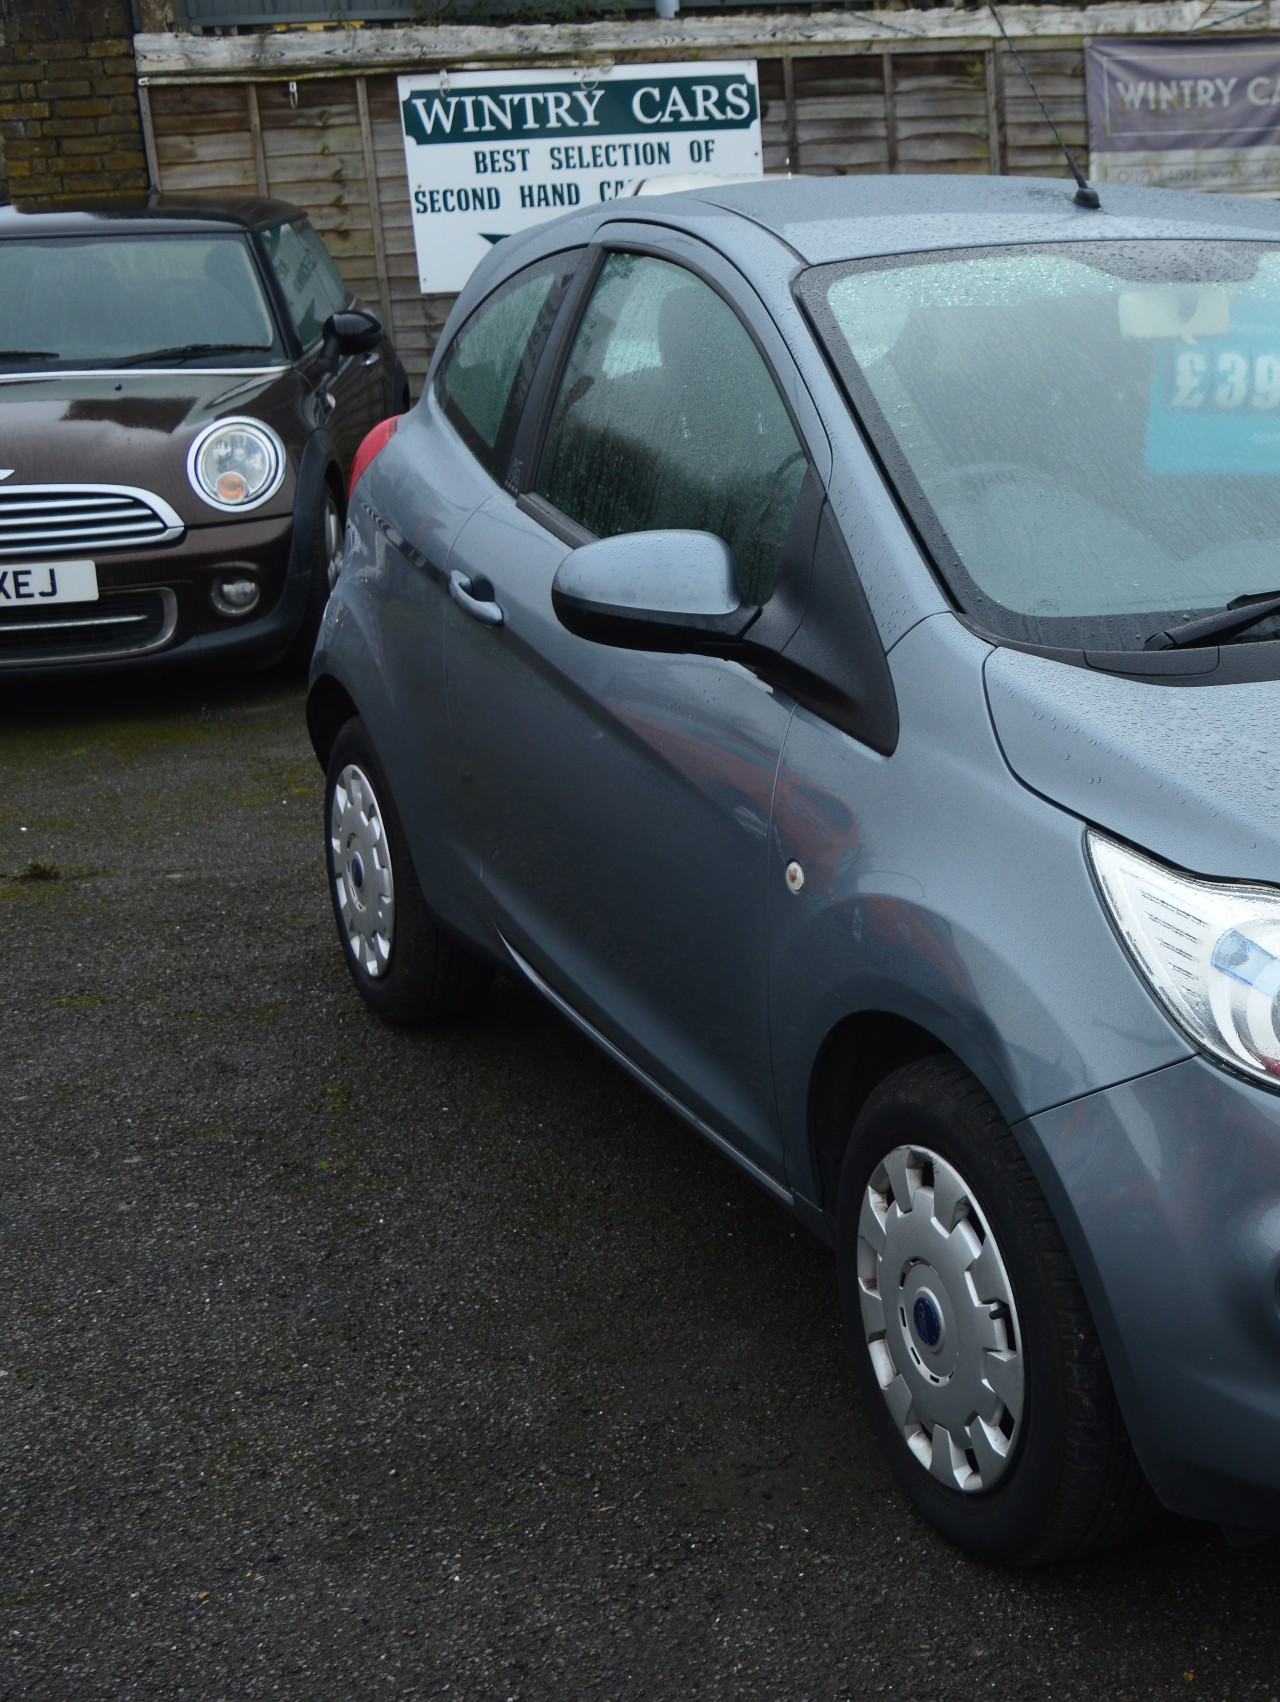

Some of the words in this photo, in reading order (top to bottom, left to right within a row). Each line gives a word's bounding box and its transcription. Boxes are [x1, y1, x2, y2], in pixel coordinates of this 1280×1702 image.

[412, 89, 606, 135] WINTRY
[631, 83, 752, 125] CARS
[1116, 78, 1238, 111] WINTRY
[474, 148, 530, 174] BEST
[550, 141, 671, 171] SELECTION
[689, 139, 716, 163] OF
[414, 186, 501, 214] SECOND
[520, 182, 580, 208] HAND
